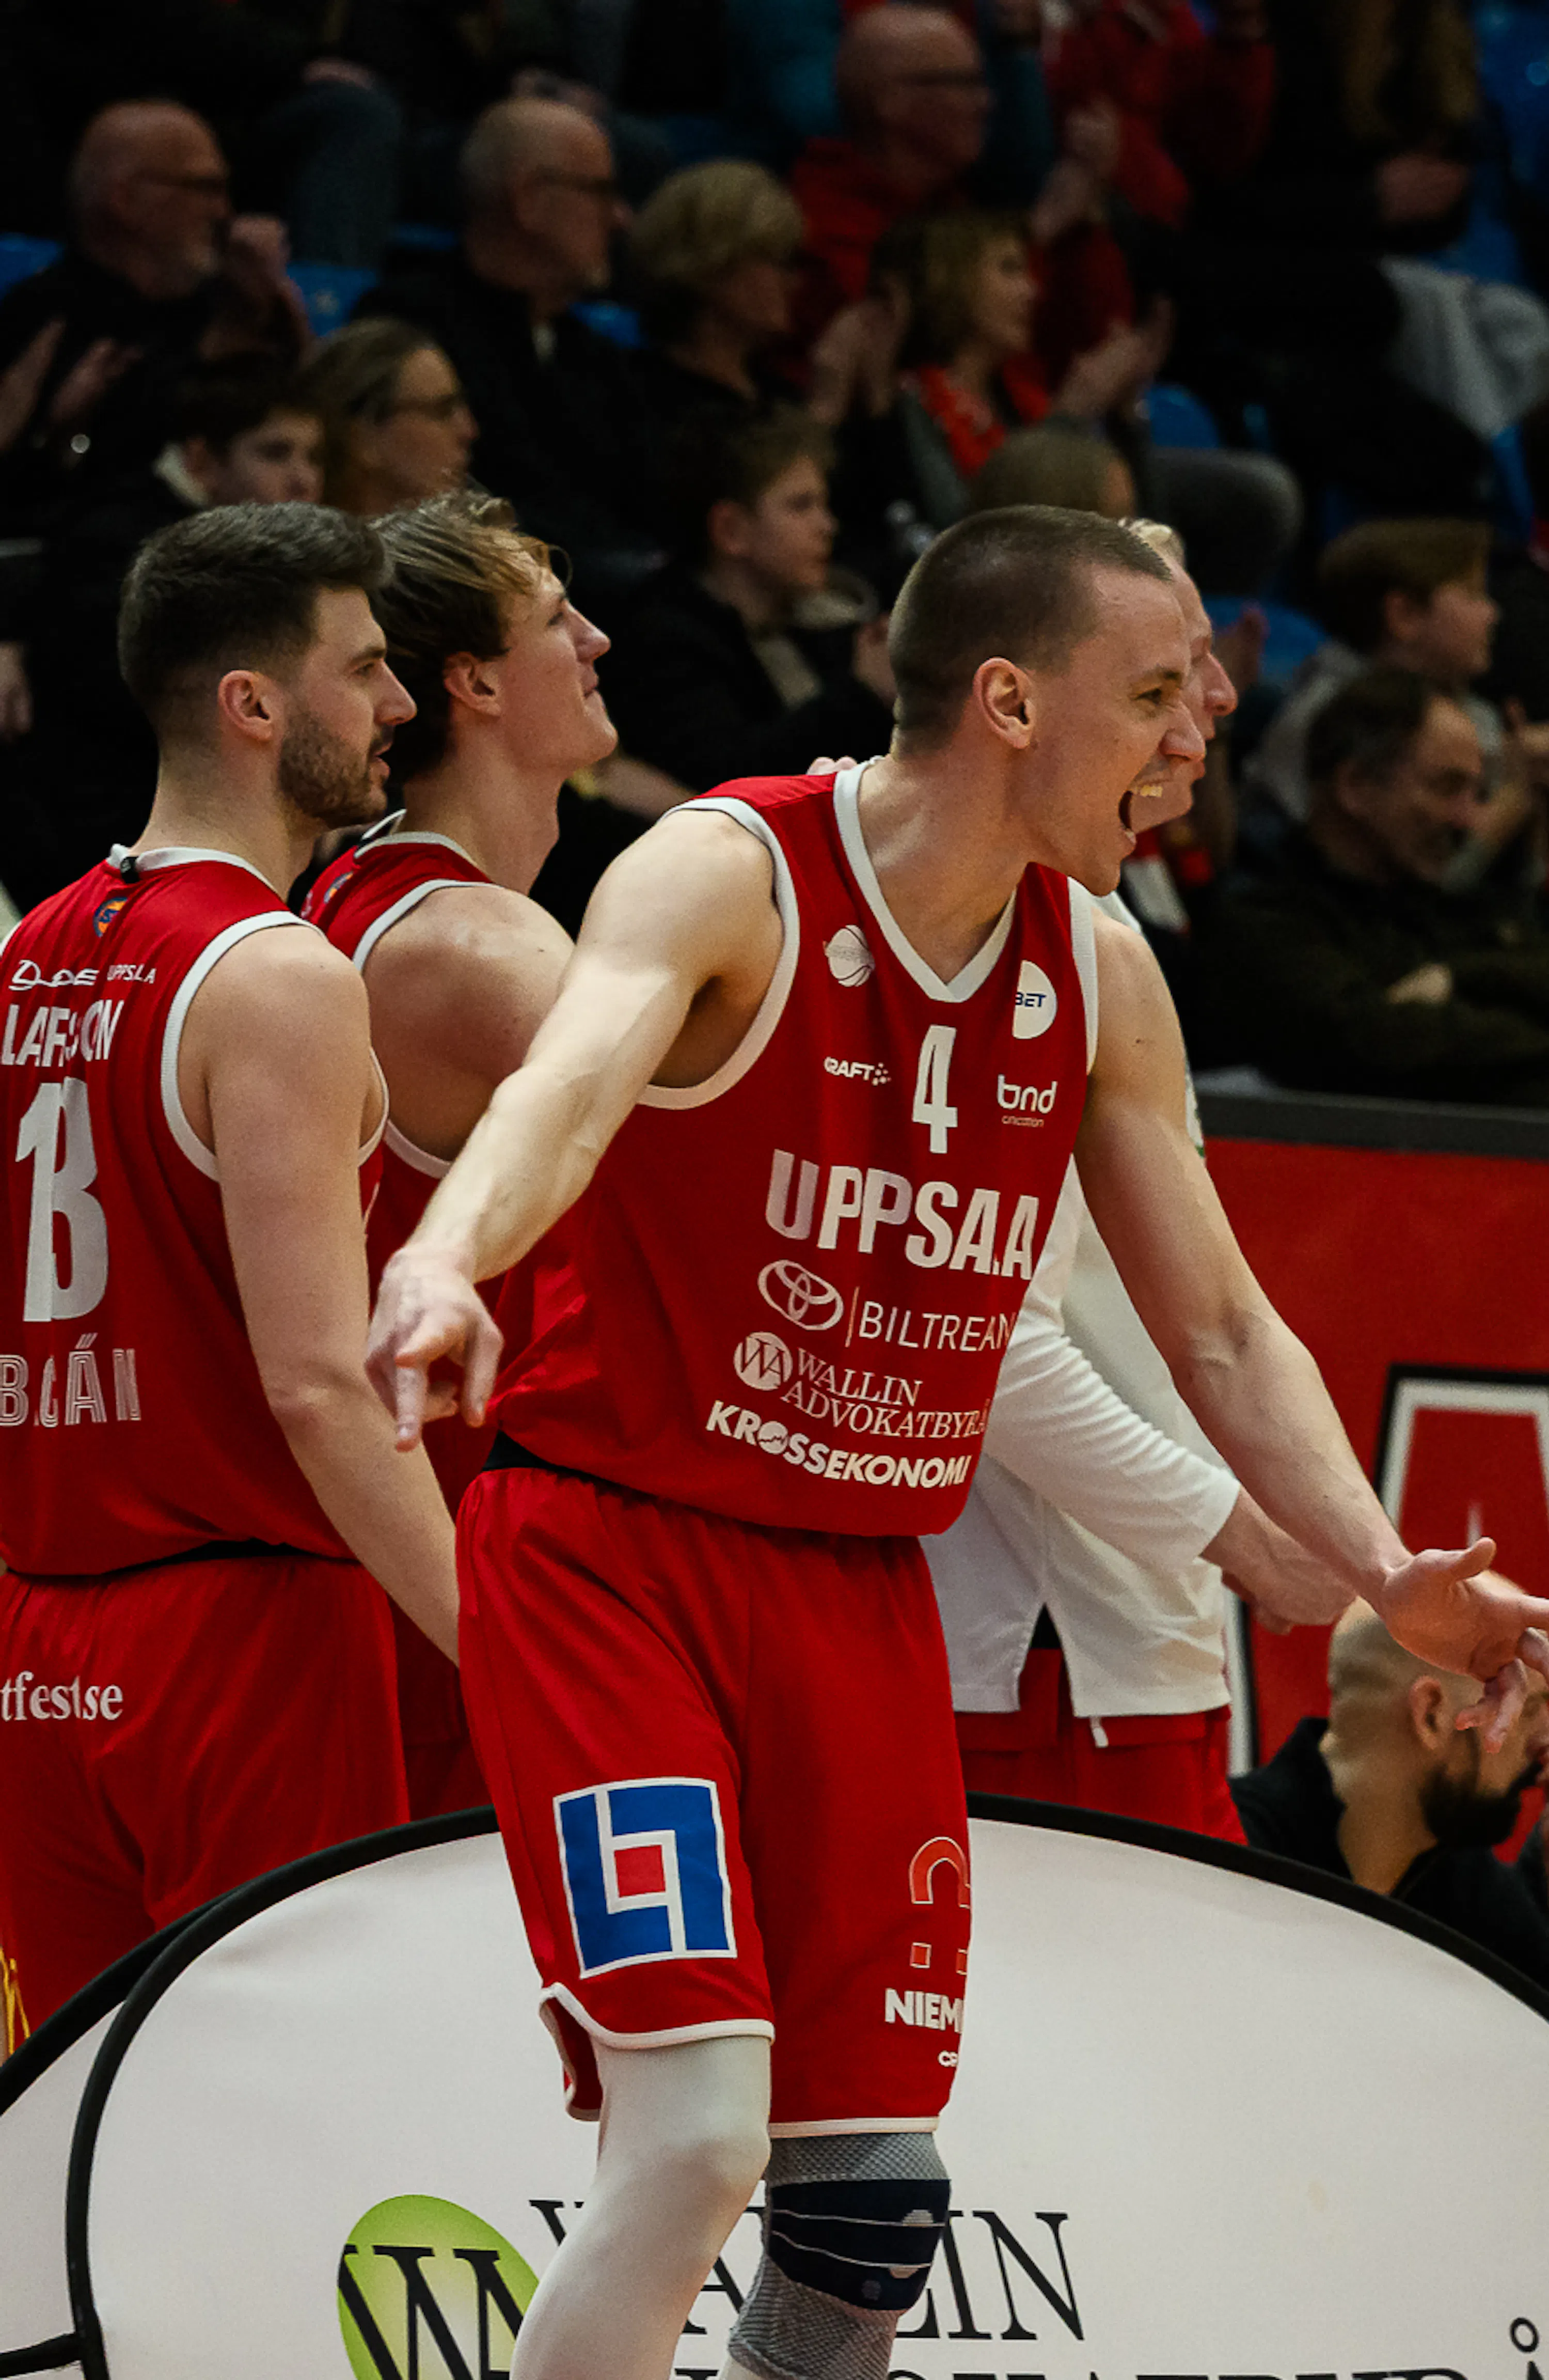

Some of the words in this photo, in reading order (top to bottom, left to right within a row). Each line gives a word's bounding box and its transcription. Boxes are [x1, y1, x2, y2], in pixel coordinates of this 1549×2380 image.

[912, 1025, 958, 1153] 4
[997, 1074, 1057, 1114] bnd
[765, 1149, 1039, 1280] UPPSAA
[797, 1348, 922, 1406] WALLIN
[706, 1400, 973, 1489] KROSSEKONOMI
